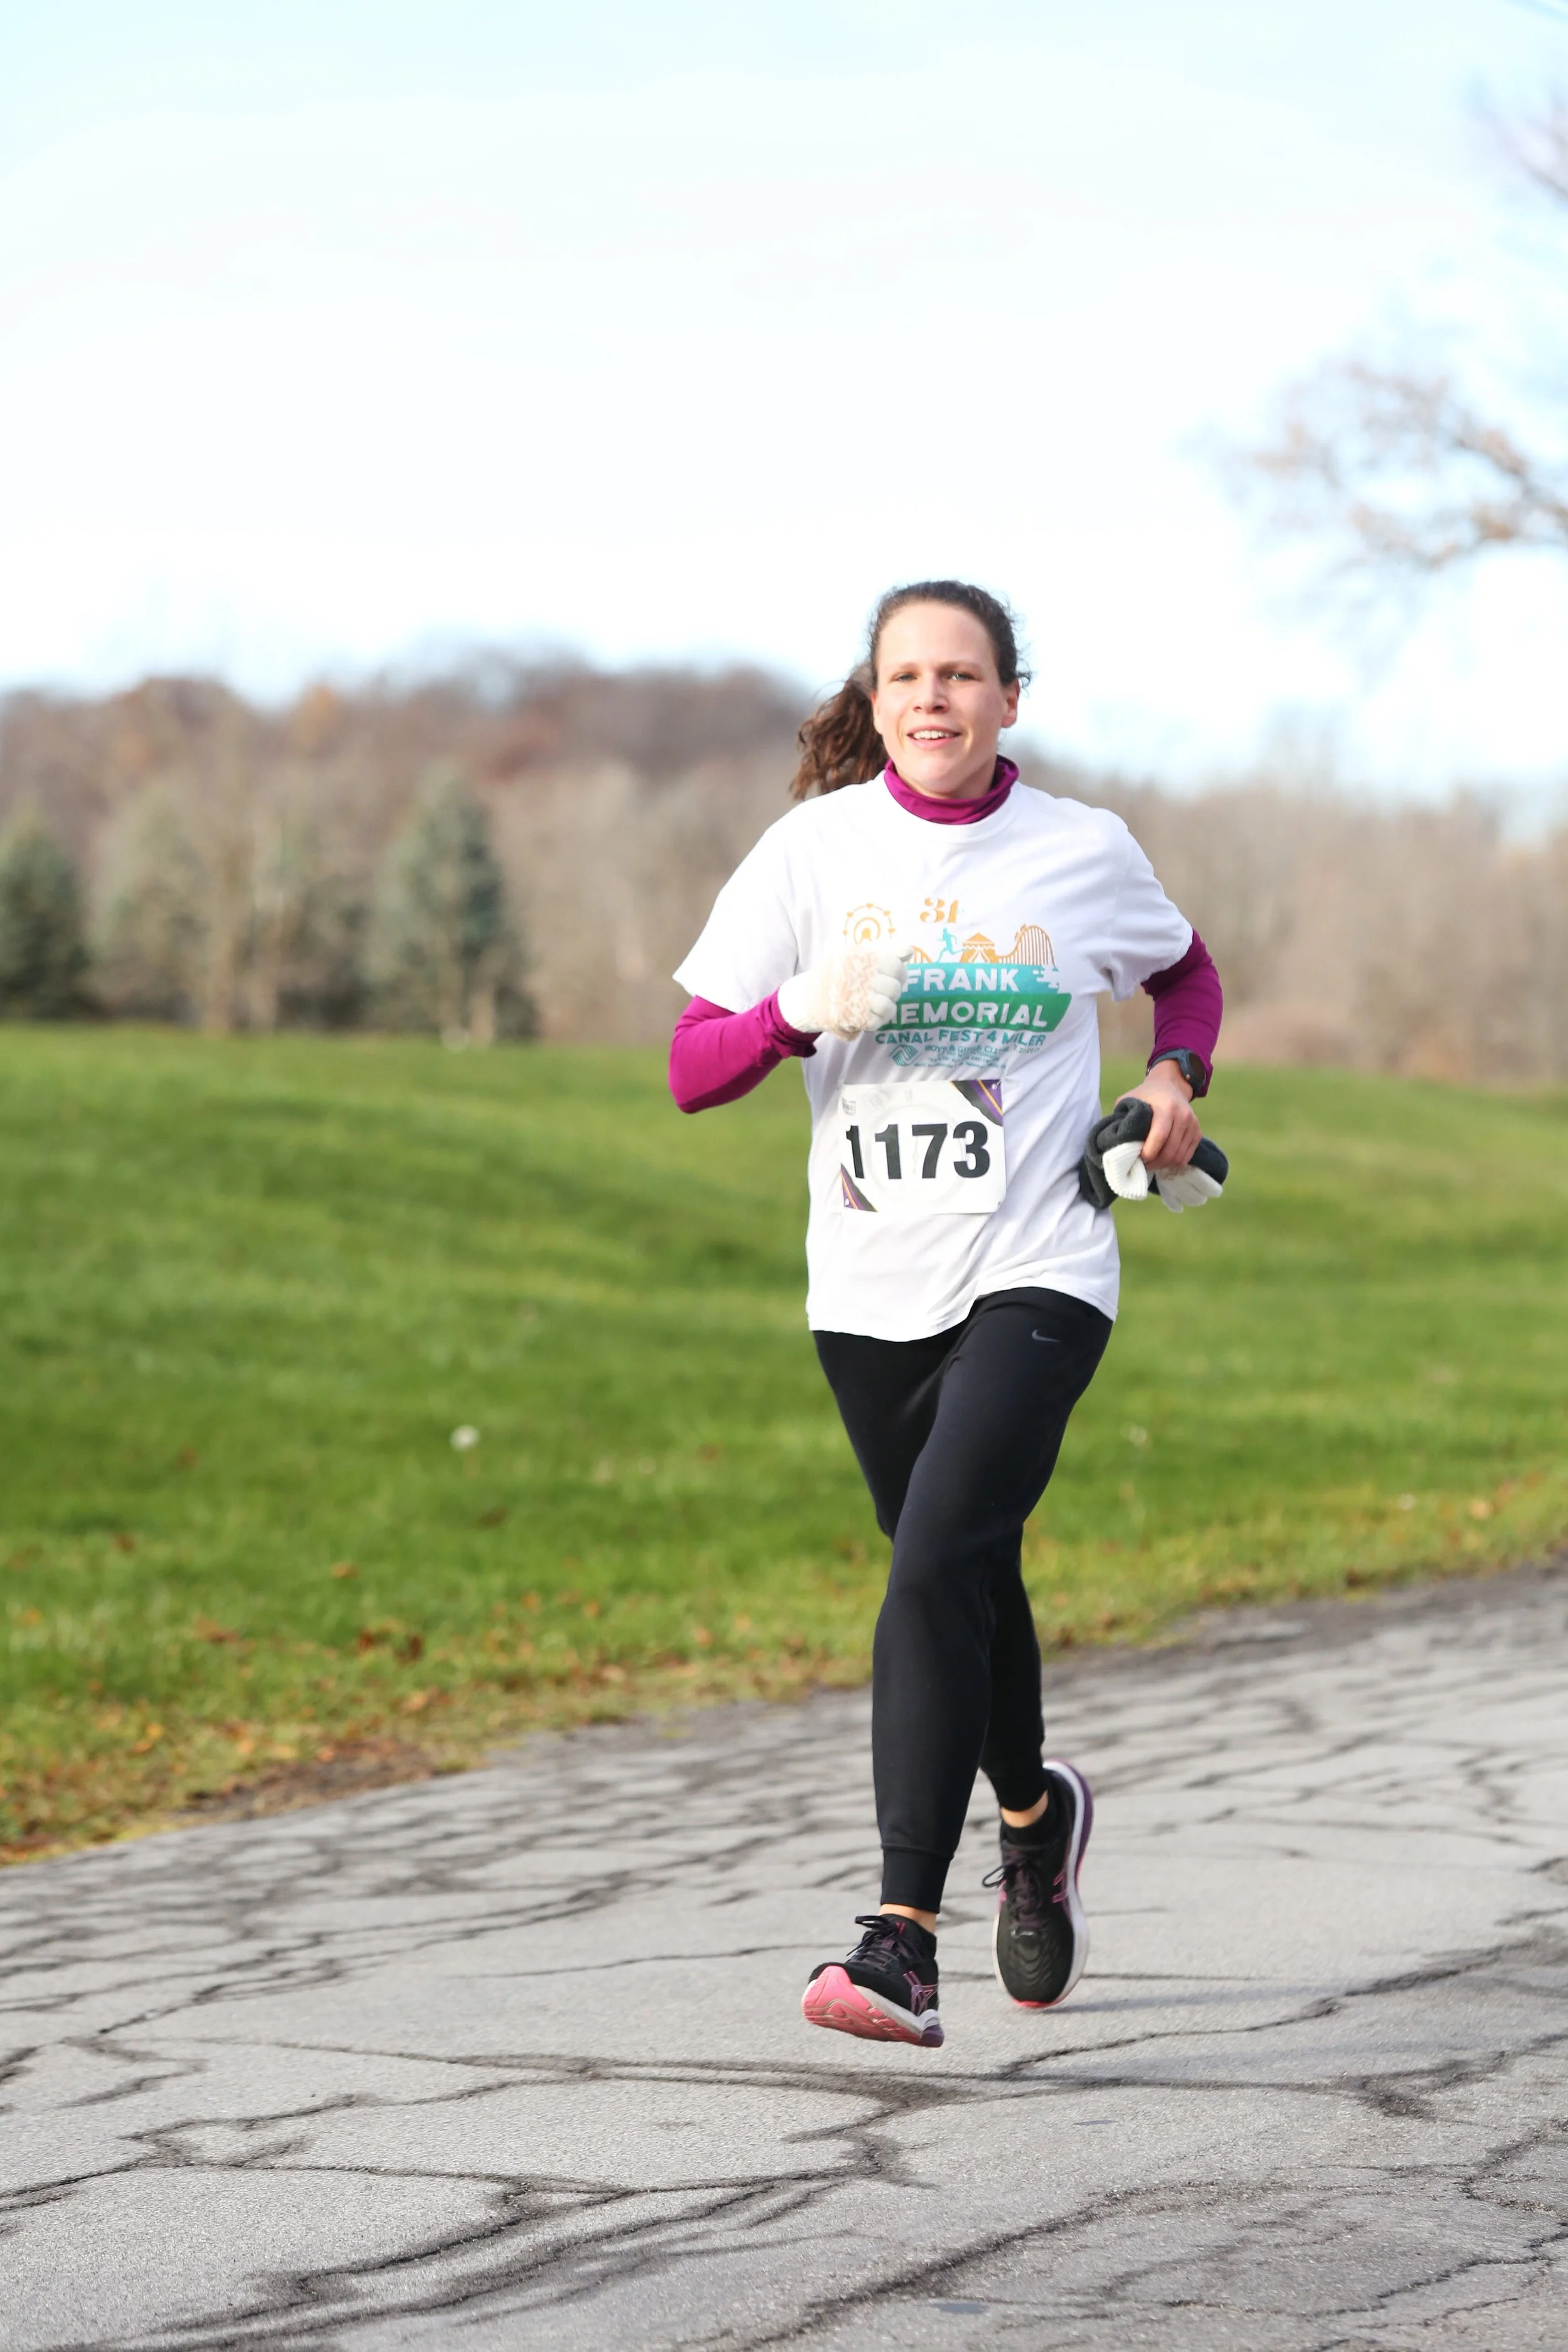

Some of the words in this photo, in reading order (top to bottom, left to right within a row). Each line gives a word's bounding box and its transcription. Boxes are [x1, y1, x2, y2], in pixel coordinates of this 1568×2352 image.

[903, 968, 1019, 993] FRANK
[875, 1032, 933, 1044] CANAL
[939, 1029, 983, 1042] FEST
[987, 1030, 997, 1042] 4
[846, 1121, 990, 1179] 1173
